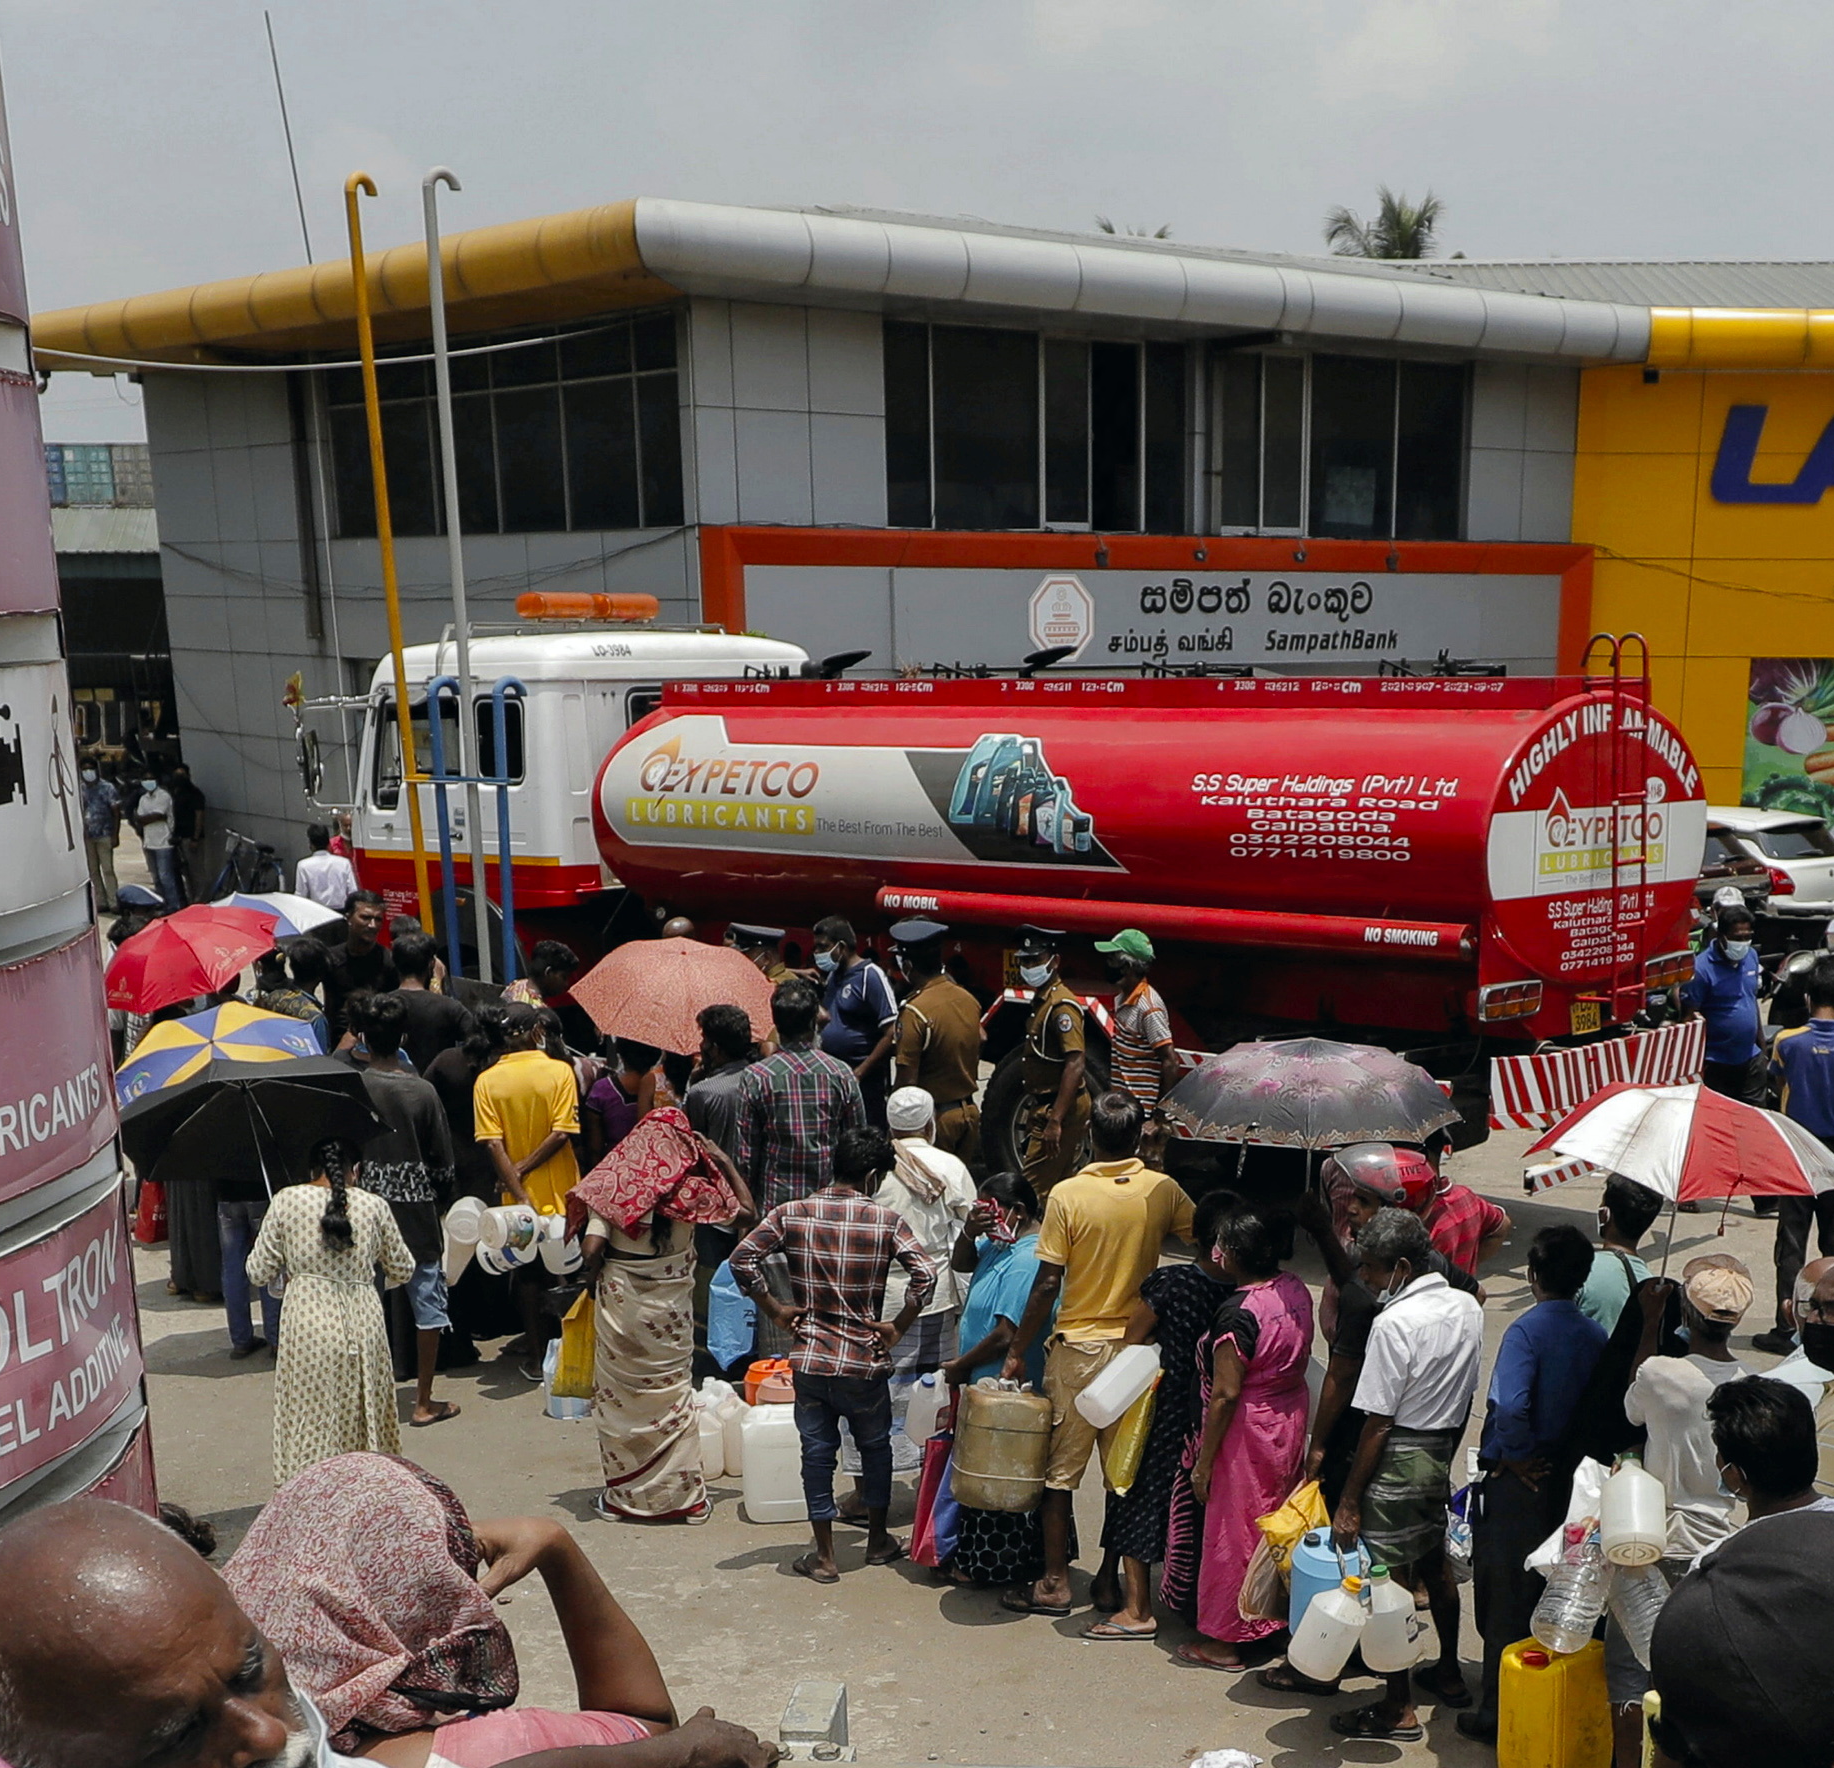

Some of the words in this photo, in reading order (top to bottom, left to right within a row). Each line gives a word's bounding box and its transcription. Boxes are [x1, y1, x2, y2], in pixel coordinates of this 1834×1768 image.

[1507, 710, 1577, 806] HIGHLY
[1191, 774, 1221, 792] S.S
[1225, 774, 1278, 796] Super
[1361, 775, 1414, 794] (Pvt)
[1201, 796, 1347, 808] Kaluthara
[1358, 797, 1439, 811] Road
[632, 800, 808, 831] LUBRICANTS
[1247, 808, 1396, 822] Batagoda
[818, 817, 836, 832] The
[839, 819, 862, 835] Best
[865, 820, 893, 836] From
[896, 822, 917, 837] The
[918, 822, 943, 839] Best
[1229, 834, 1411, 848] 0342208044
[1229, 847, 1411, 862] 0771419800
[883, 894, 901, 909] NO
[1365, 926, 1383, 942] NO
[1384, 928, 1439, 946] SMOKING
[1575, 1011, 1597, 1032] 3984
[46, 1312, 130, 1432] ADDITIVE
